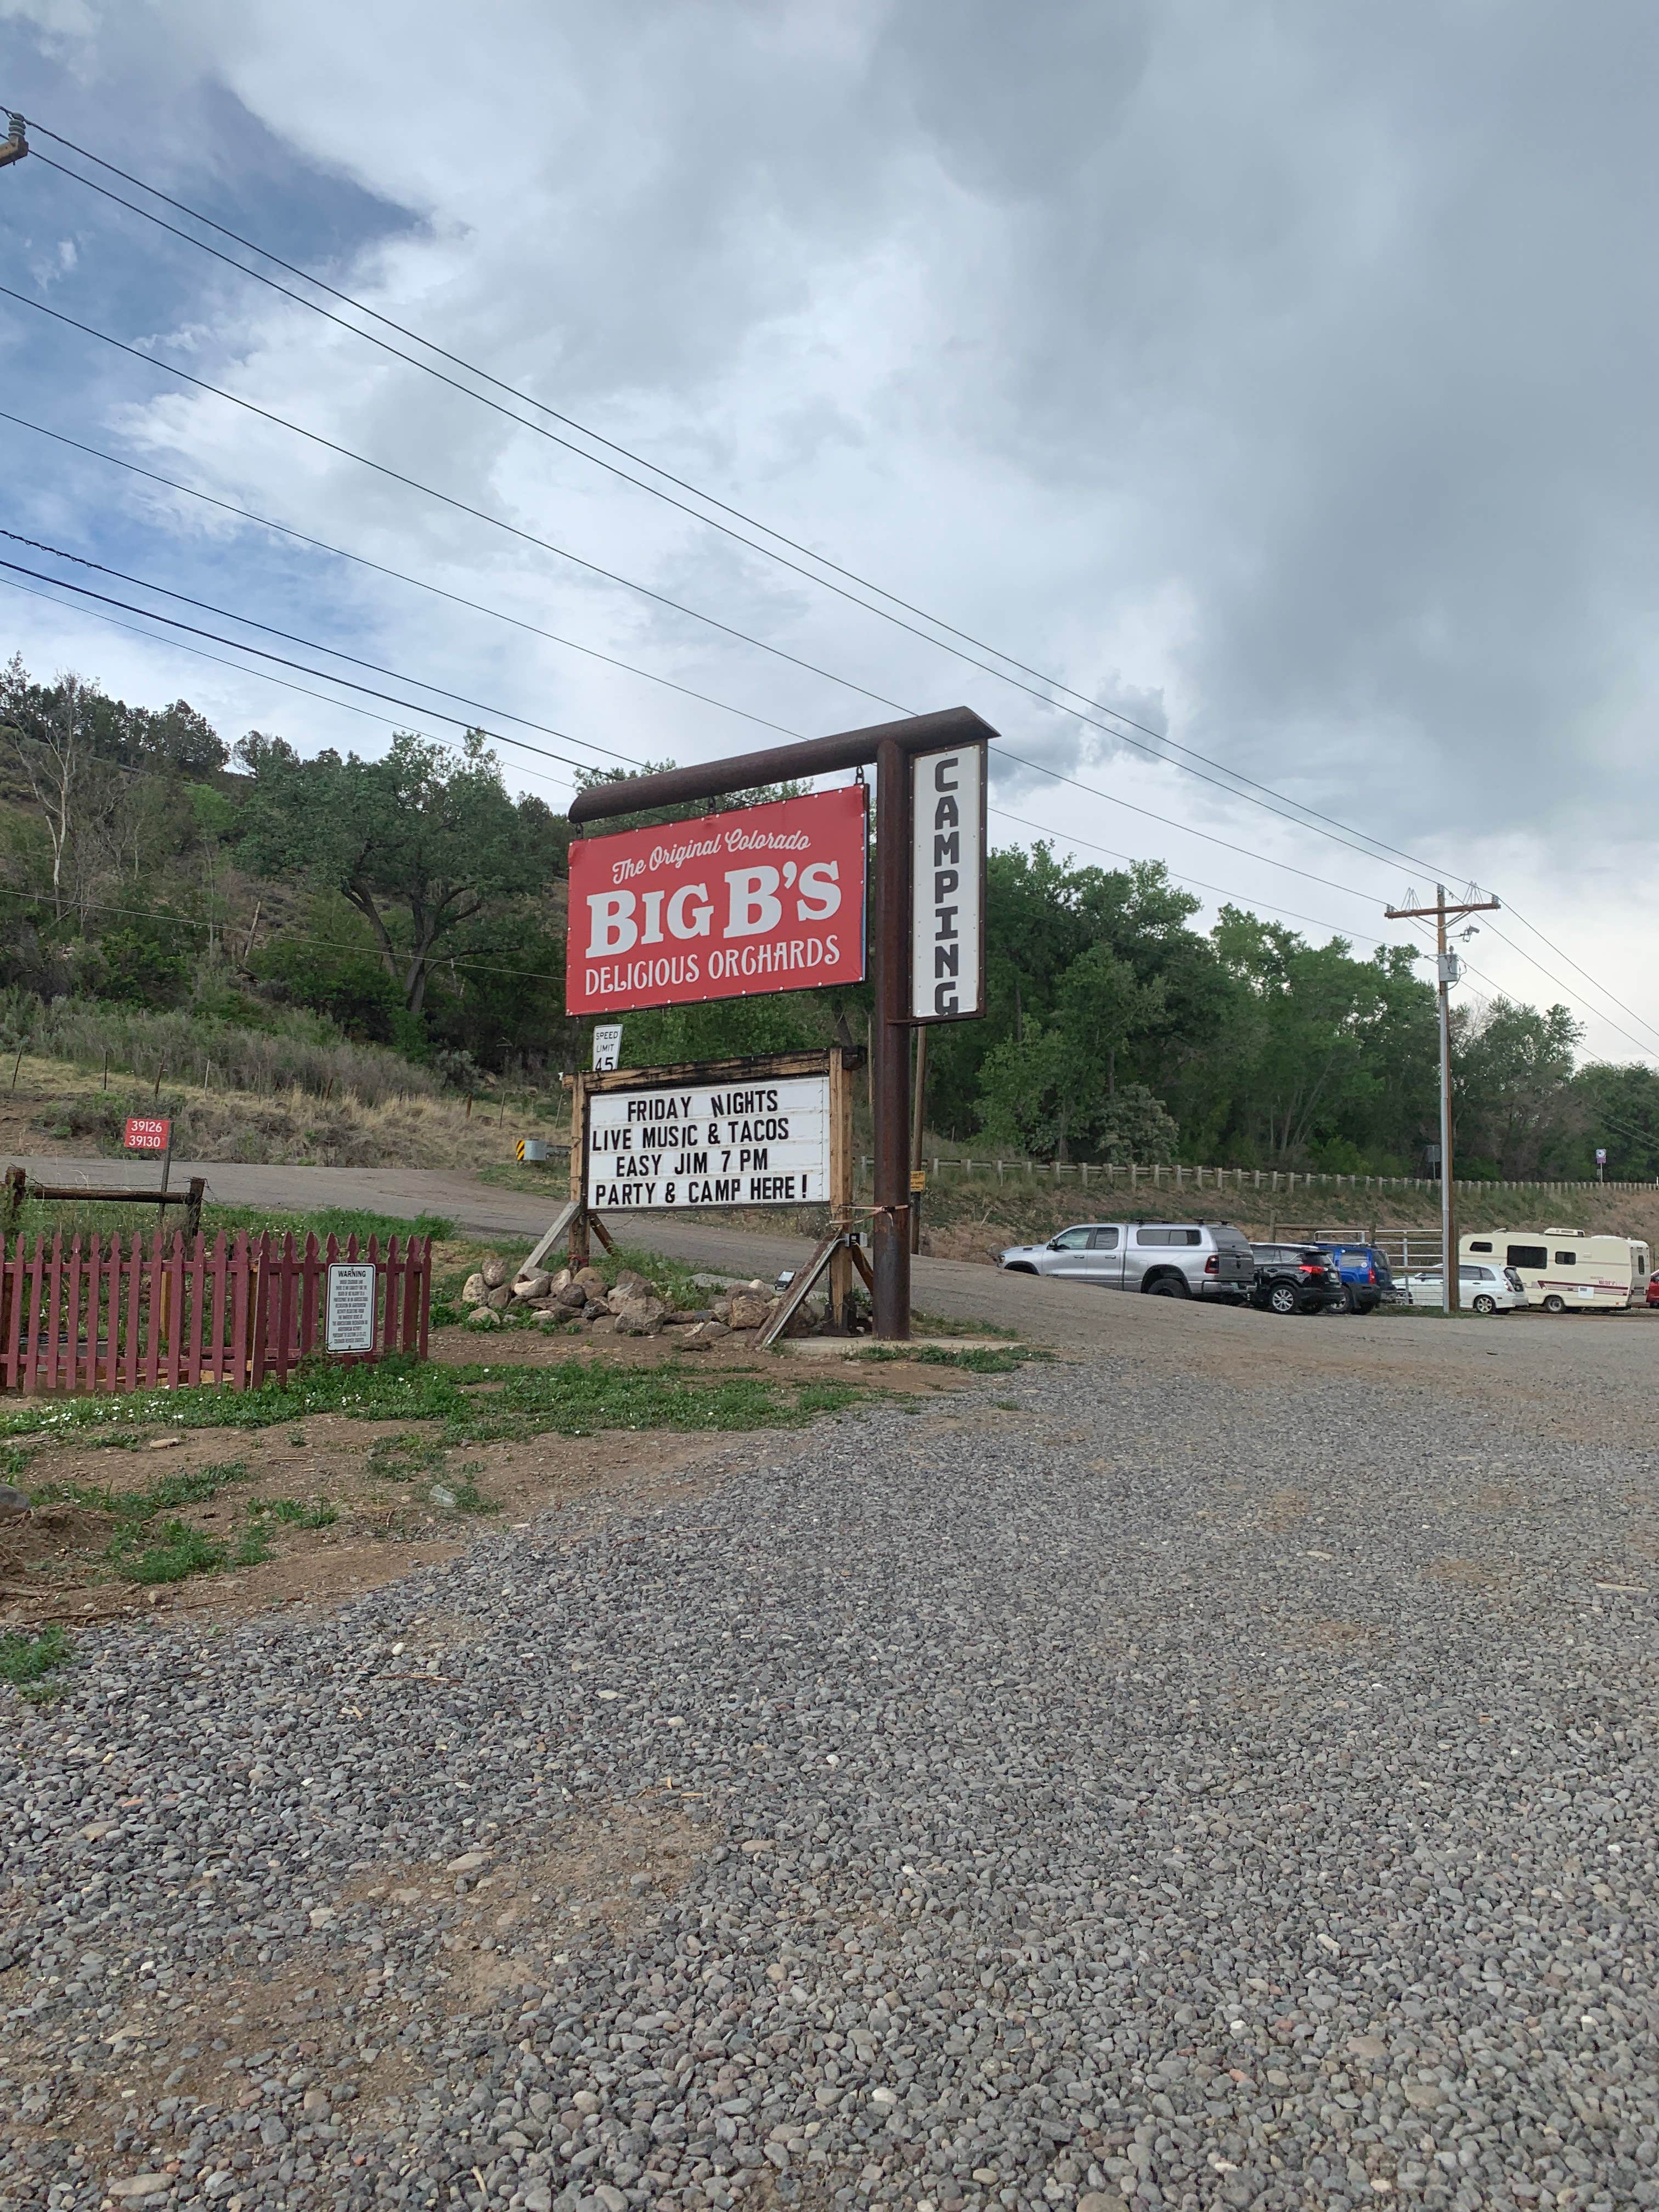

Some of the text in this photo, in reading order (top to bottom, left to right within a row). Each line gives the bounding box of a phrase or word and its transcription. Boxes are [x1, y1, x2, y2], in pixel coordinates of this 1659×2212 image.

[613, 829, 811, 884] The Original Colorado
[934, 758, 960, 1015] CAMPING
[586, 861, 841, 958] BIG B'S
[586, 935, 839, 995] DELICIOUS ORCHARDS
[596, 1031, 618, 1040] SPEED
[596, 1044, 614, 1052] LIMIT
[595, 1057, 614, 1071] 45
[628, 1090, 777, 1122] FRIDAY NIGHTS
[131, 1120, 162, 1132] 39126
[592, 1118, 788, 1151] LIVE MUSIC & TACOS
[128, 1135, 160, 1147] 39130
[617, 1148, 767, 1177] EASY JIM 7 PM
[596, 1183, 656, 1205] PARTY
[665, 1182, 675, 1203] &
[689, 1179, 740, 1203] CAMP
